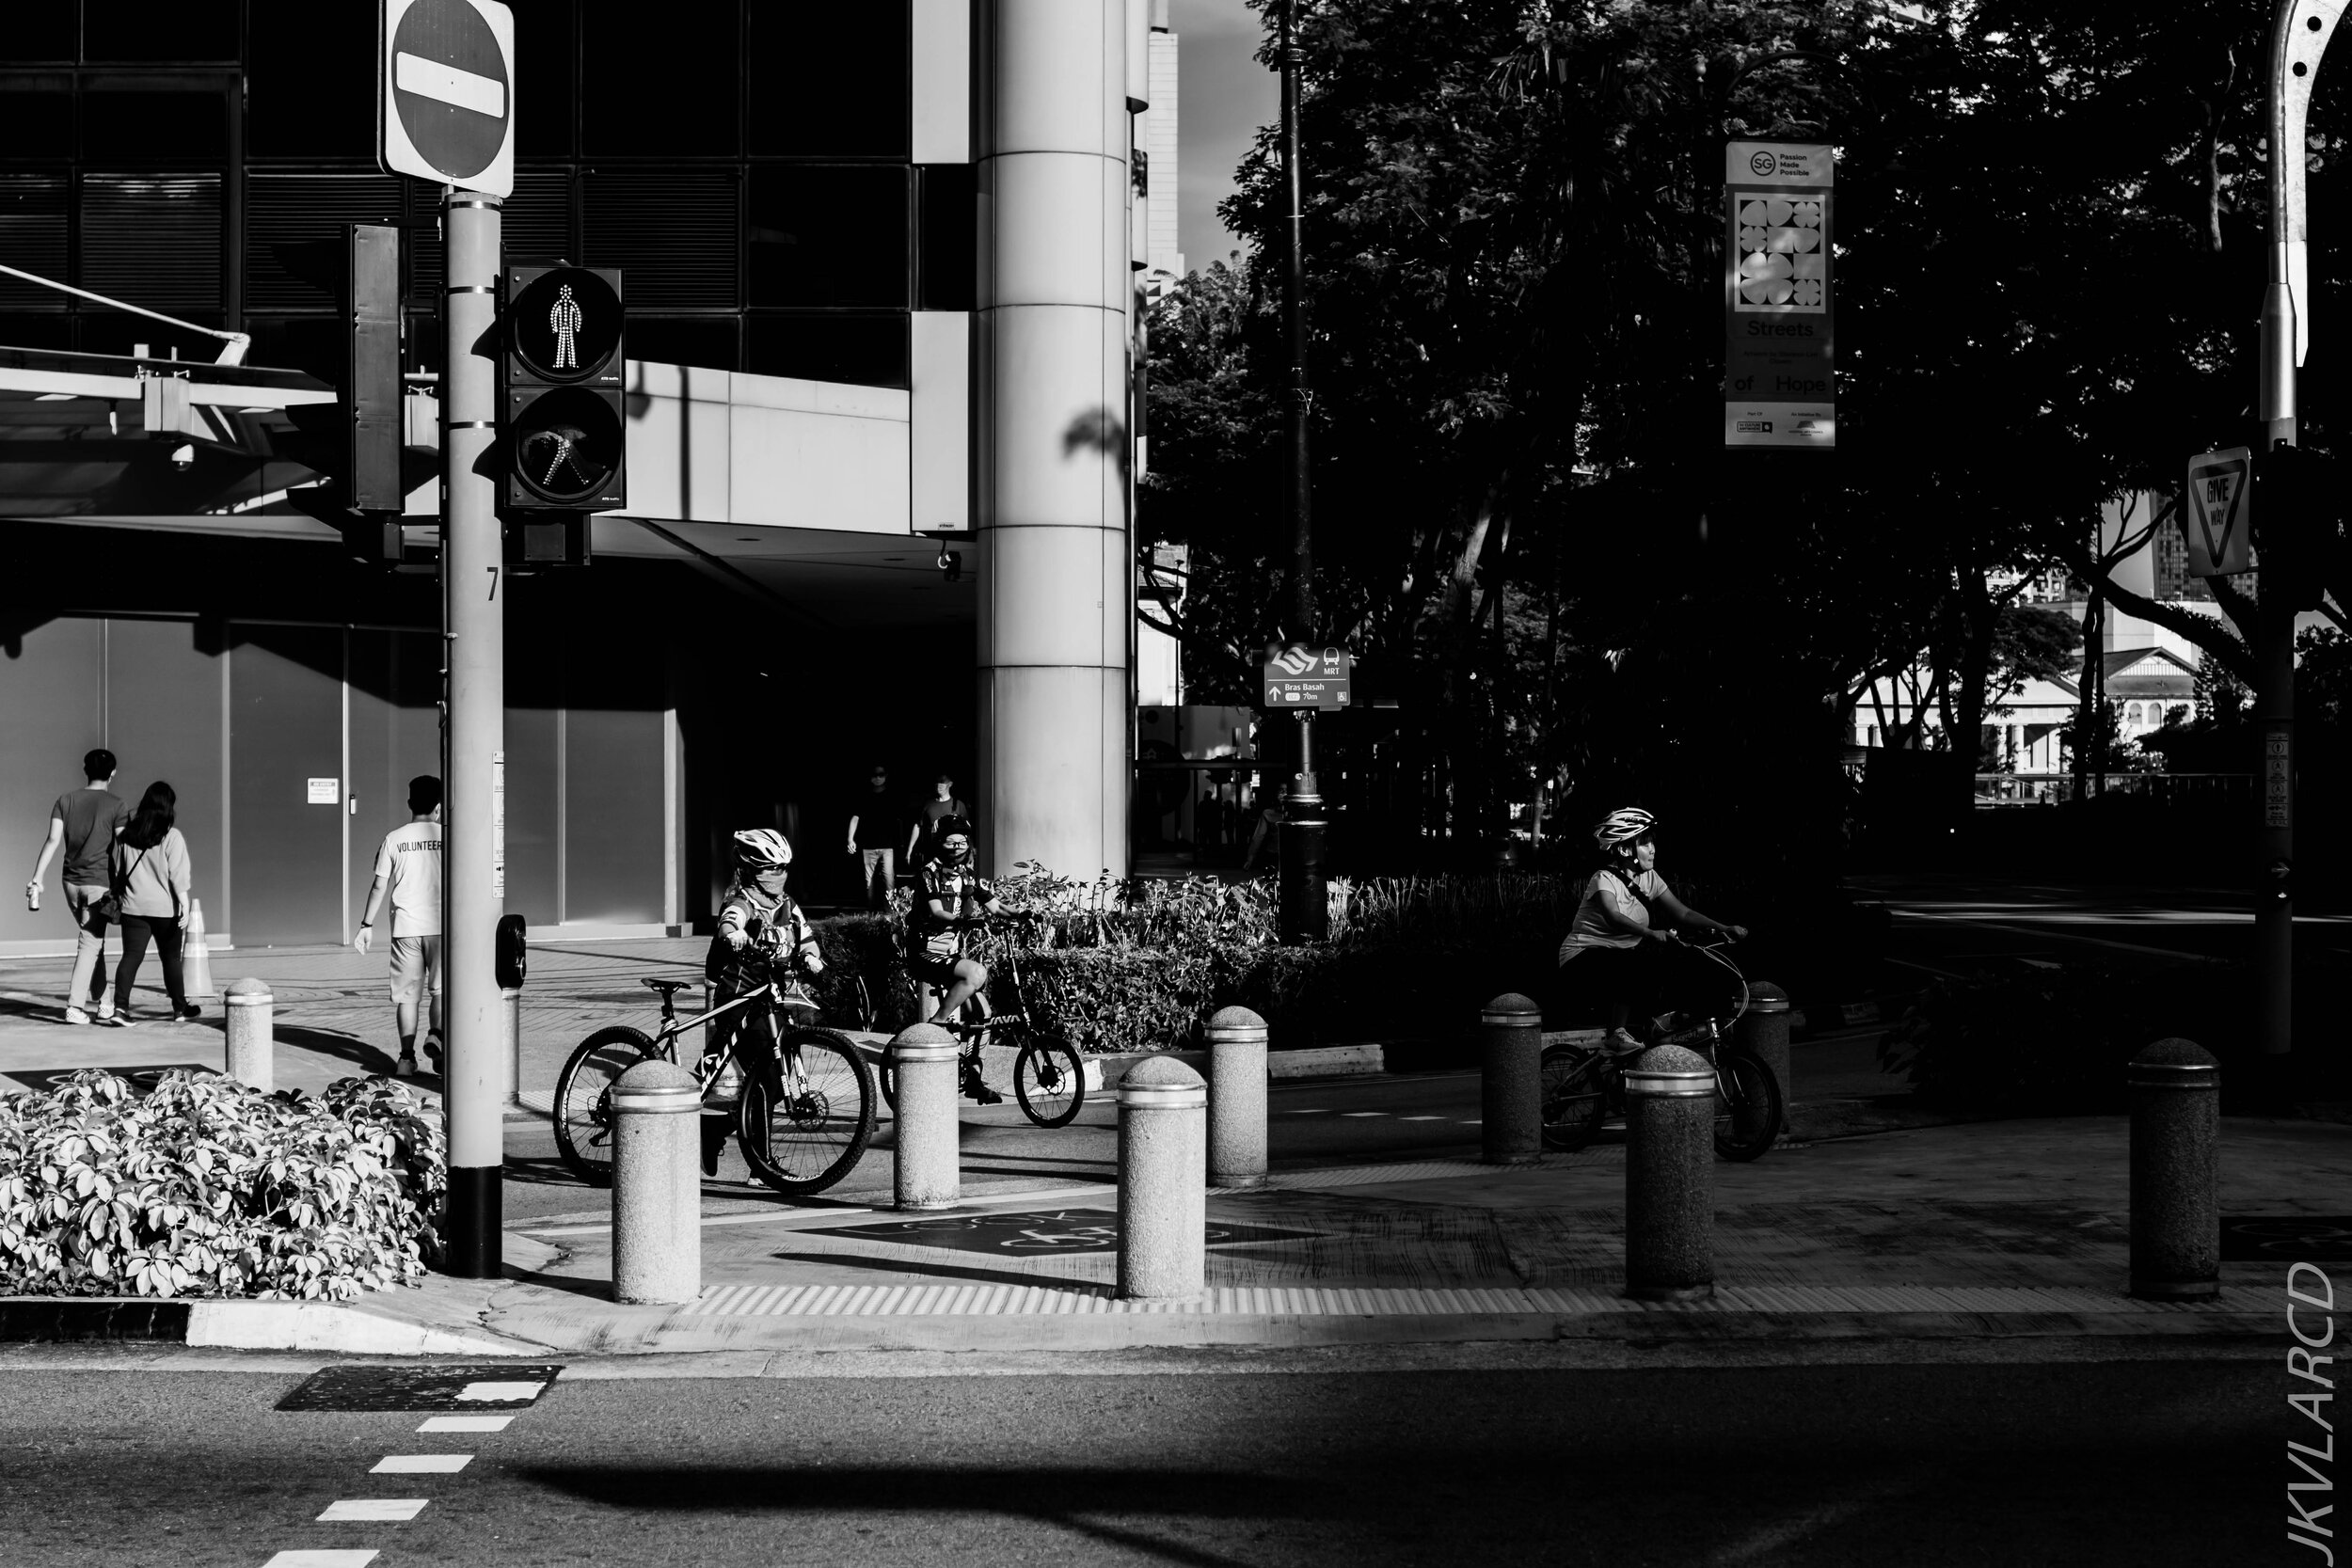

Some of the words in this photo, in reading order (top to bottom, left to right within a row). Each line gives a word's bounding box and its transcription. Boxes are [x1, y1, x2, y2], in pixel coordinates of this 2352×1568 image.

[1755, 158, 1772, 169] SG
[1747, 320, 1814, 337] Streets
[1735, 375, 1755, 390] of
[1776, 375, 1826, 395] Hope
[2207, 478, 2229, 503] GIVE
[2211, 508, 2225, 526] WAY
[487, 566, 499, 602] 7
[1285, 683, 1301, 691] Bras
[1303, 683, 1325, 691] Basah
[397, 840, 442, 853] VOLUNTEER
[984, 1015, 1022, 1026] JAVA
[835, 1211, 1110, 1235] LOOK
